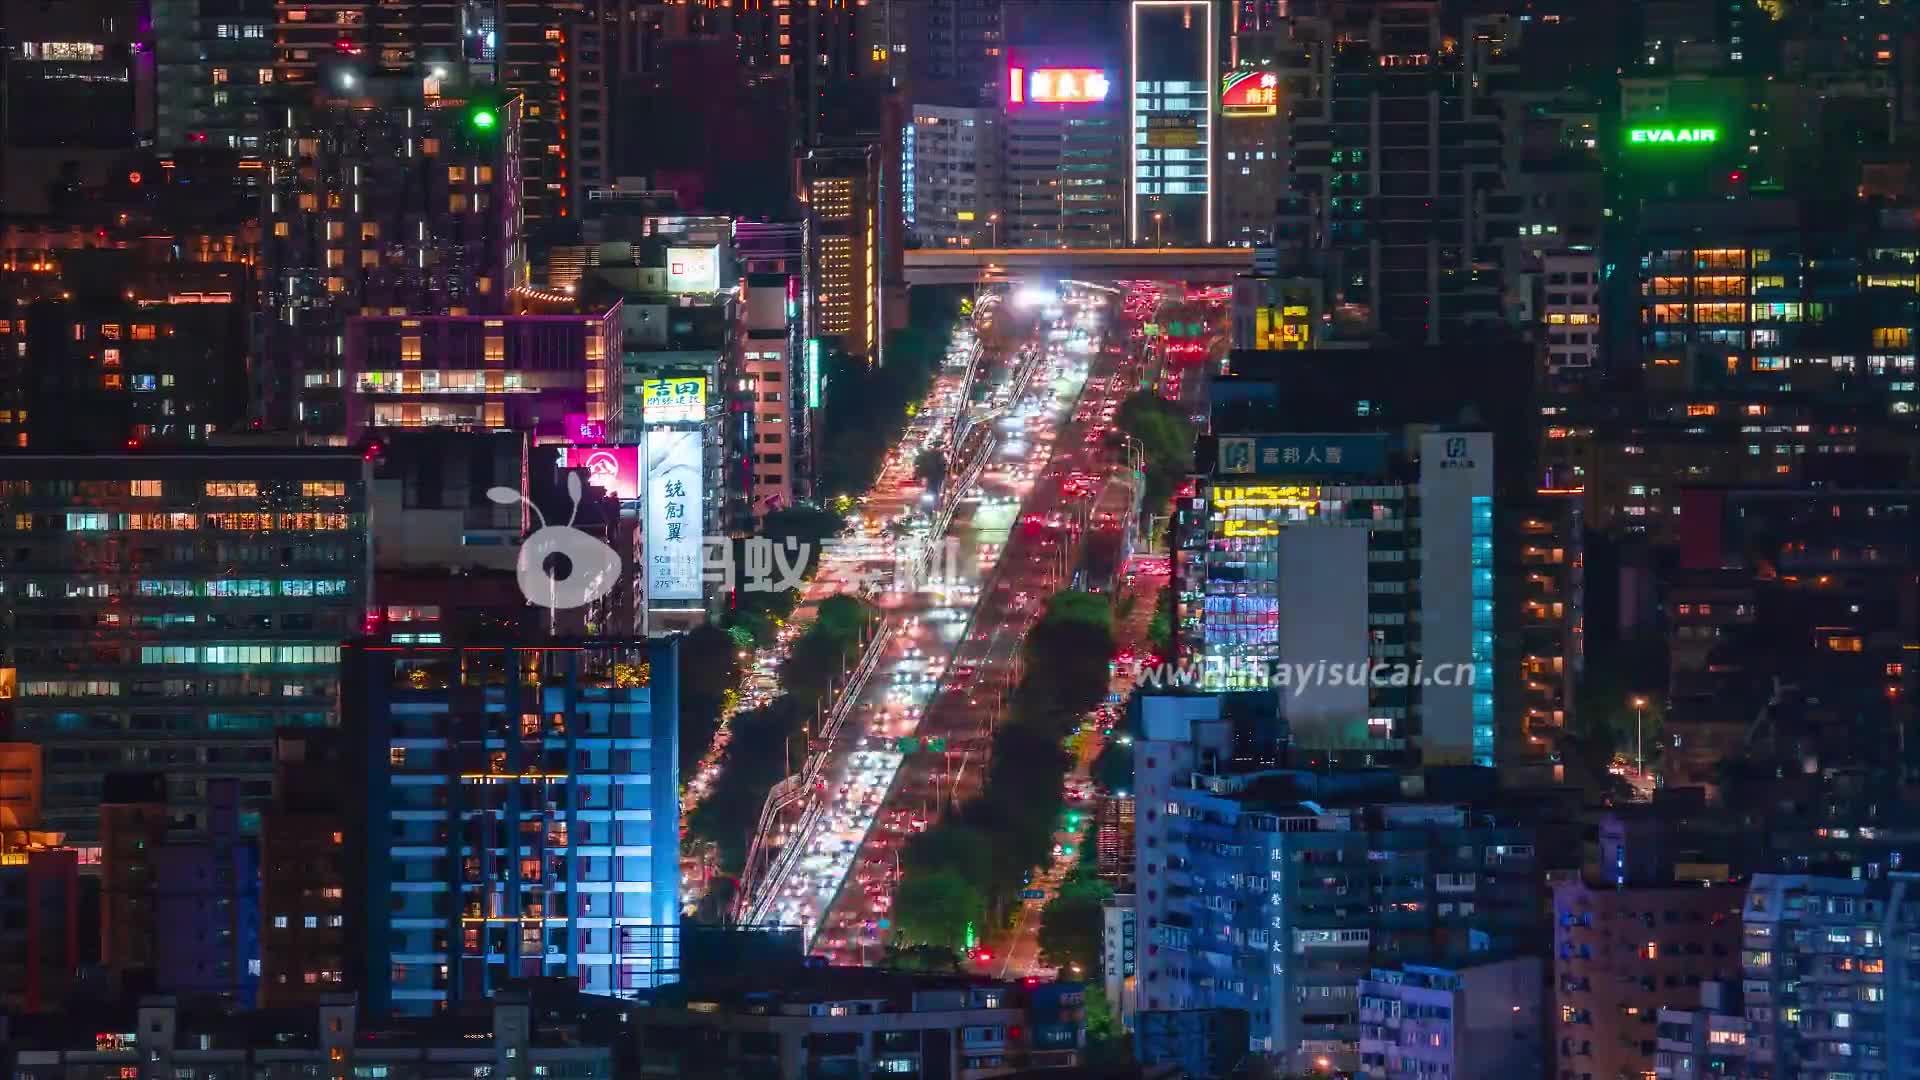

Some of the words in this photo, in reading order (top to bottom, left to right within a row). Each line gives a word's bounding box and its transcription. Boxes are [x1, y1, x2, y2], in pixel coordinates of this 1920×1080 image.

[1631, 129, 1675, 142] EVA
[1677, 129, 1716, 142] AIR
[647, 377, 700, 396] 吉田
